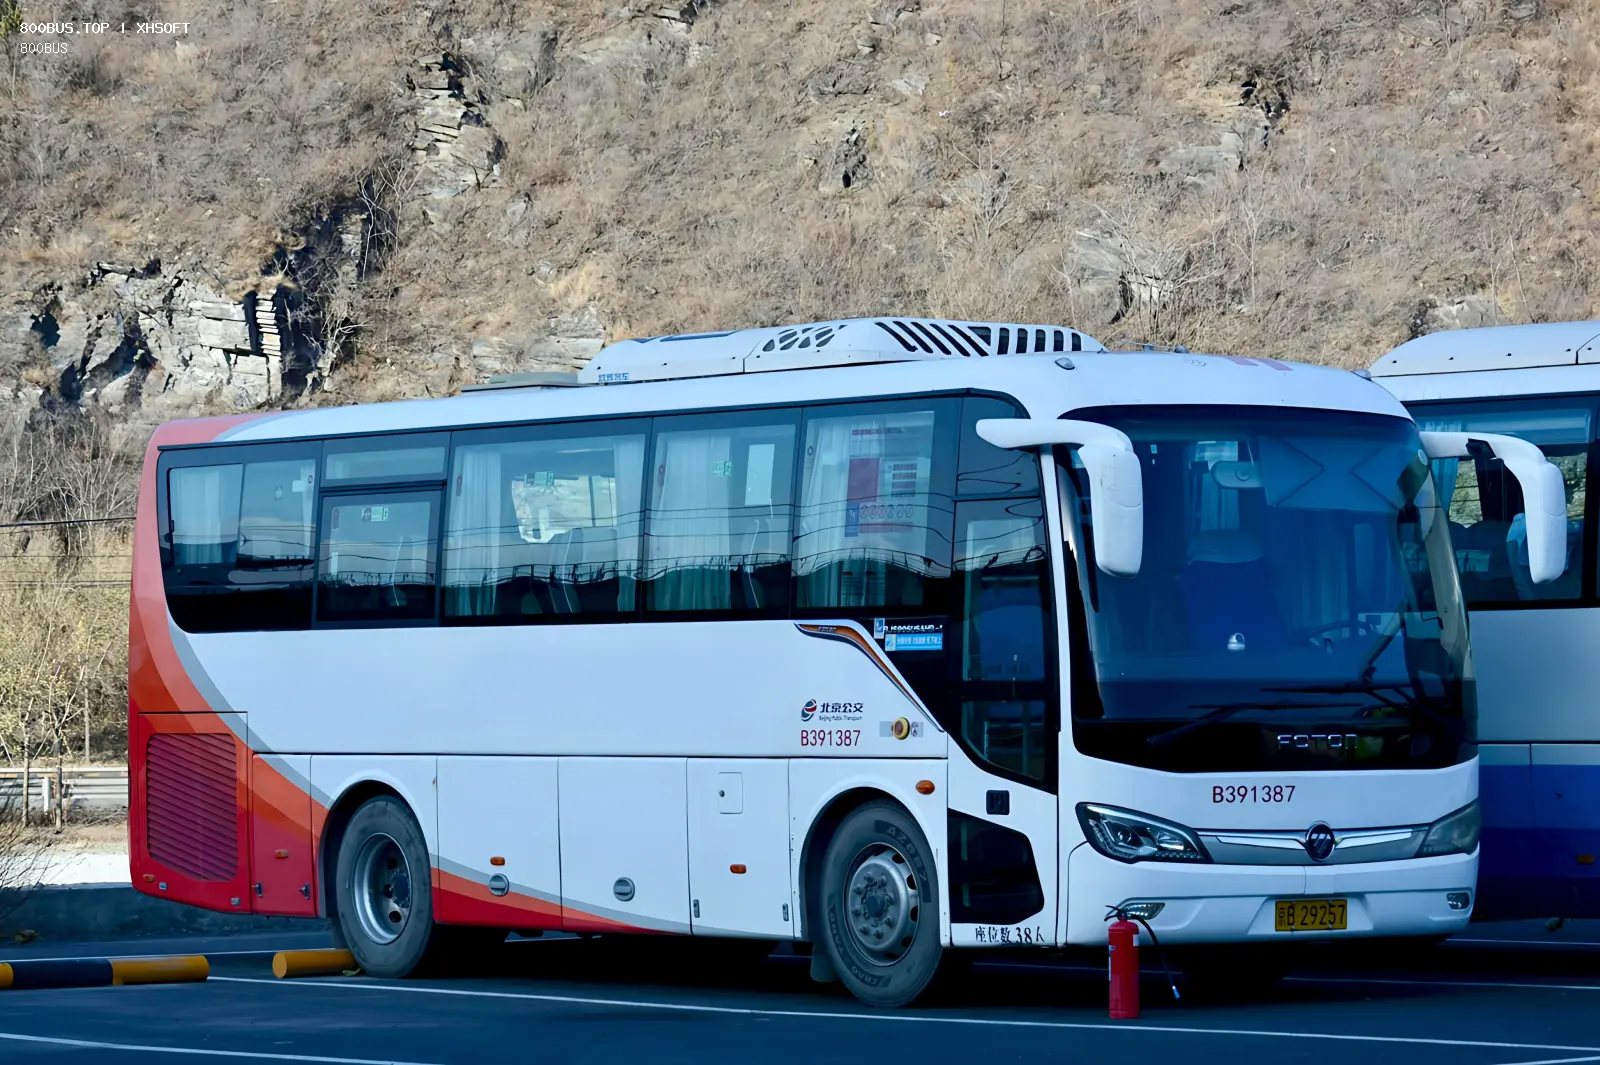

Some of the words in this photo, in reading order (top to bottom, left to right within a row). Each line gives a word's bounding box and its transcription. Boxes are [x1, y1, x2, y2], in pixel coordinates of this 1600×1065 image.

[820, 702, 864, 713] 北京公交
[800, 729, 861, 747] B391387
[1277, 733, 1358, 749] FOTON
[1212, 785, 1296, 804] B391387
